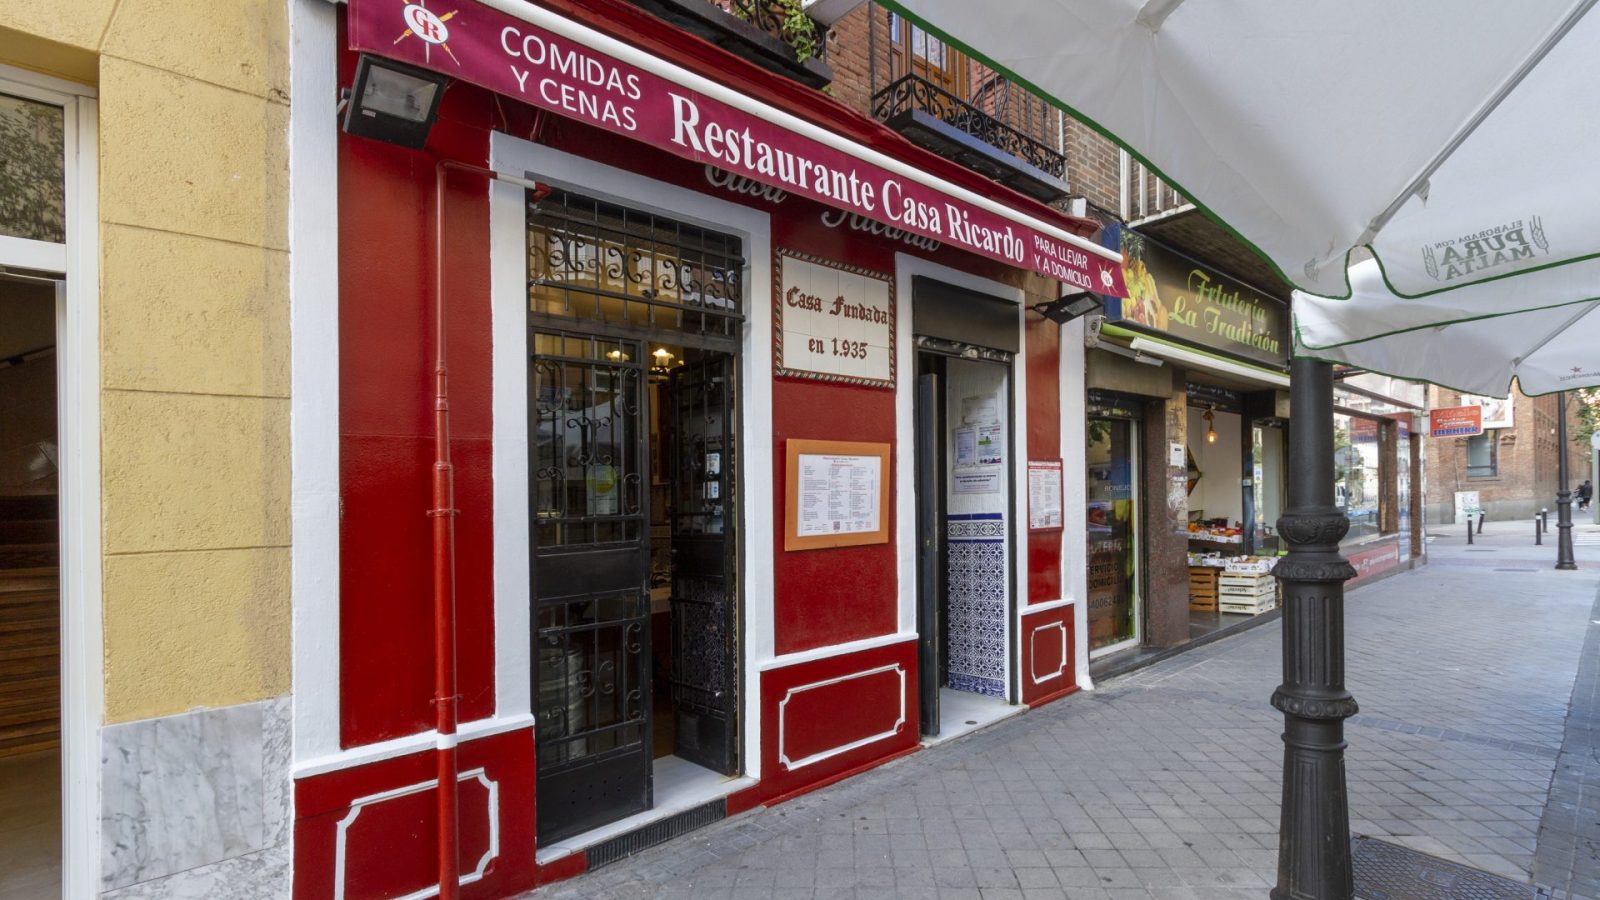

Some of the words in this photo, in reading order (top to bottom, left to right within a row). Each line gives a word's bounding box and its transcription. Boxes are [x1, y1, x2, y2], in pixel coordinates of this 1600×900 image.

[500, 26, 641, 100] COMIDAS
[510, 65, 530, 94] Y
[539, 78, 637, 131] CENAS
[667, 92, 875, 212] Restaurante
[882, 179, 943, 235] Casa
[944, 203, 1024, 263] Ricardo
[1034, 234, 1057, 259] PARA
[1058, 245, 1088, 271] LLEVAR
[1034, 253, 1041, 270] Y
[1042, 257, 1050, 273] A
[1051, 261, 1092, 289] DOMICILIO
[786, 286, 823, 313] Casa
[829, 295, 888, 325] Fundada
[1167, 296, 1199, 329] La
[1204, 306, 1279, 355] Tradición
[808, 338, 825, 355] en
[831, 337, 868, 360] 1.935
